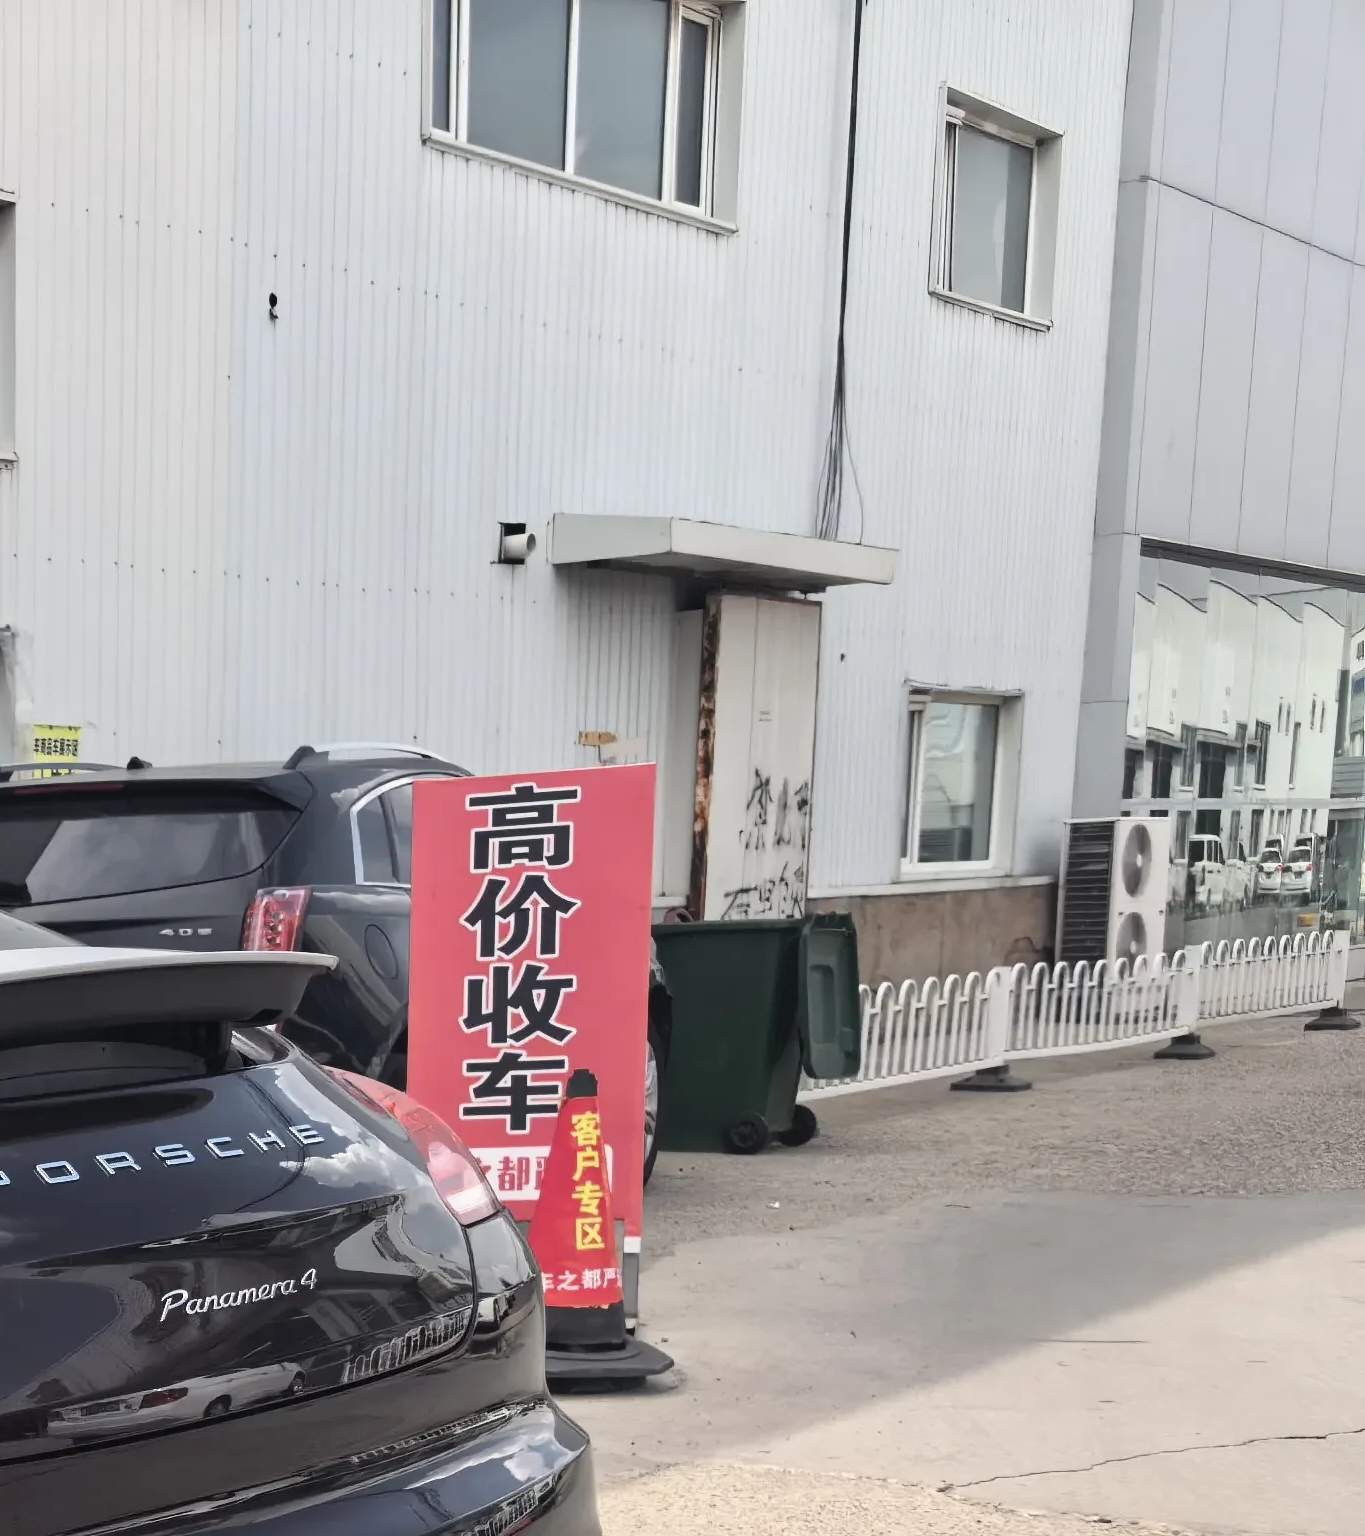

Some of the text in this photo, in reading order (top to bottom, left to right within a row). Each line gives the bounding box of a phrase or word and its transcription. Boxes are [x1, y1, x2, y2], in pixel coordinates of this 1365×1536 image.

[459, 783, 581, 1134] 高价收车
[571, 1111, 605, 1250] 客户专区
[159, 1268, 318, 1322] Panamera 4
